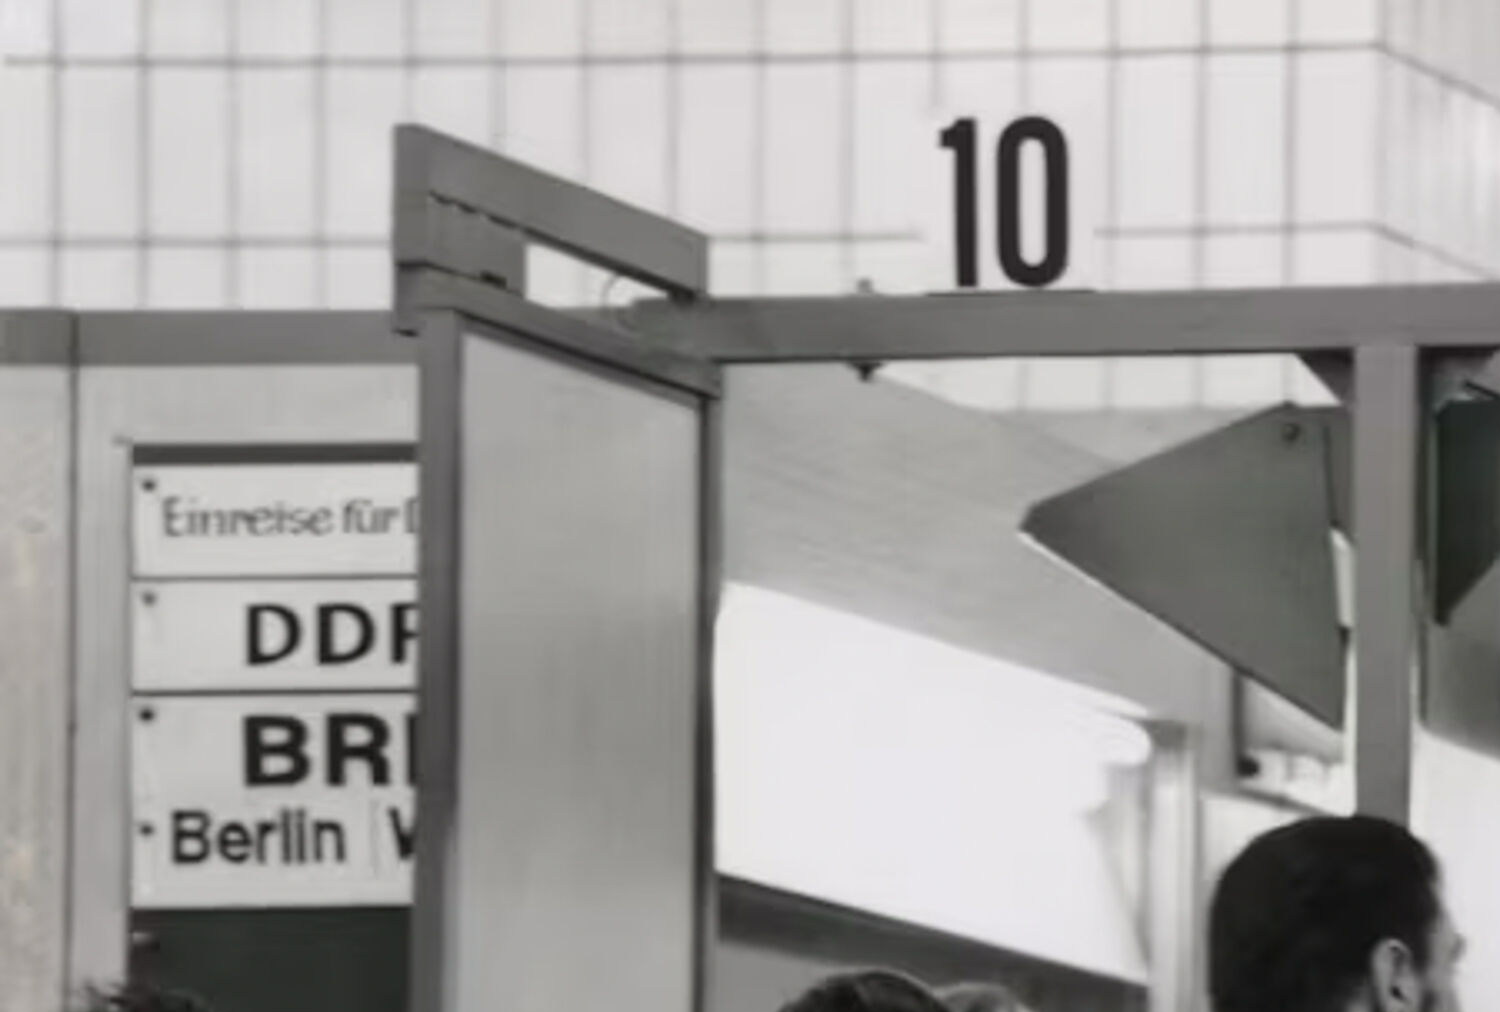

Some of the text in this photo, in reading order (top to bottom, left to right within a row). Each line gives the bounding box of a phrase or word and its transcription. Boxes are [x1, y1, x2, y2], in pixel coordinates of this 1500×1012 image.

[938, 114, 1070, 289] 10
[162, 495, 334, 538] Einreise
[342, 497, 401, 535] für
[241, 711, 416, 789] BR
[169, 806, 348, 867] Berlin
